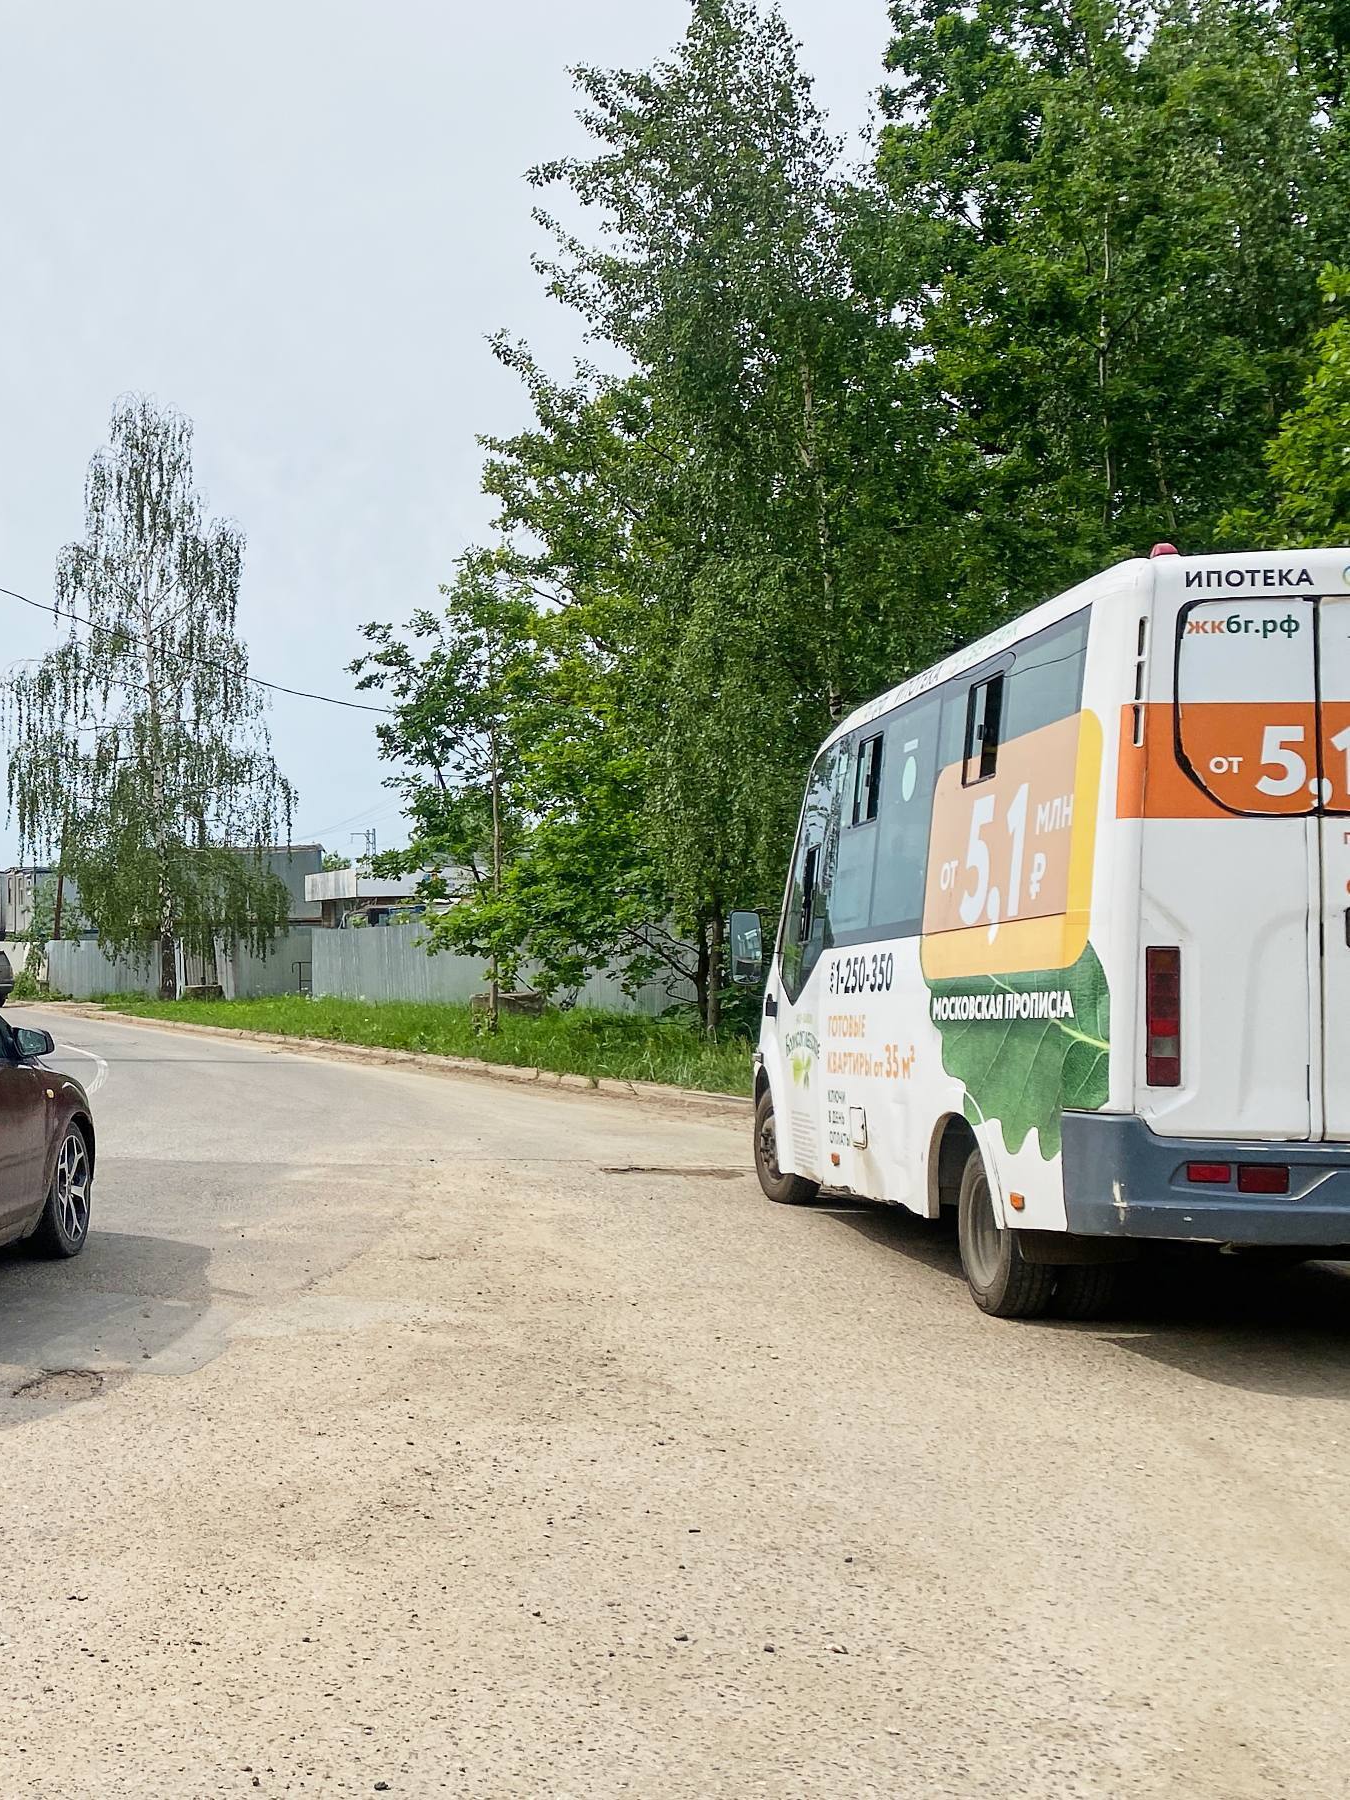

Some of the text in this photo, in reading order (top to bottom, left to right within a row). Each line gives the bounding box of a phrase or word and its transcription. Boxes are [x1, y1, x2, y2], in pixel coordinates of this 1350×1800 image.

[1185, 569, 1314, 588] ИПОТЕКА
[1187, 614, 1300, 639] жкбг.рф
[959, 783, 1030, 945] 5,1
[932, 994, 1003, 1020] МОСКОВСКАЯ
[827, 1014, 866, 1037] ГОТОВЫЕ
[827, 1052, 872, 1076] КВАРТИРЫ
[885, 1043, 899, 1079] 35
